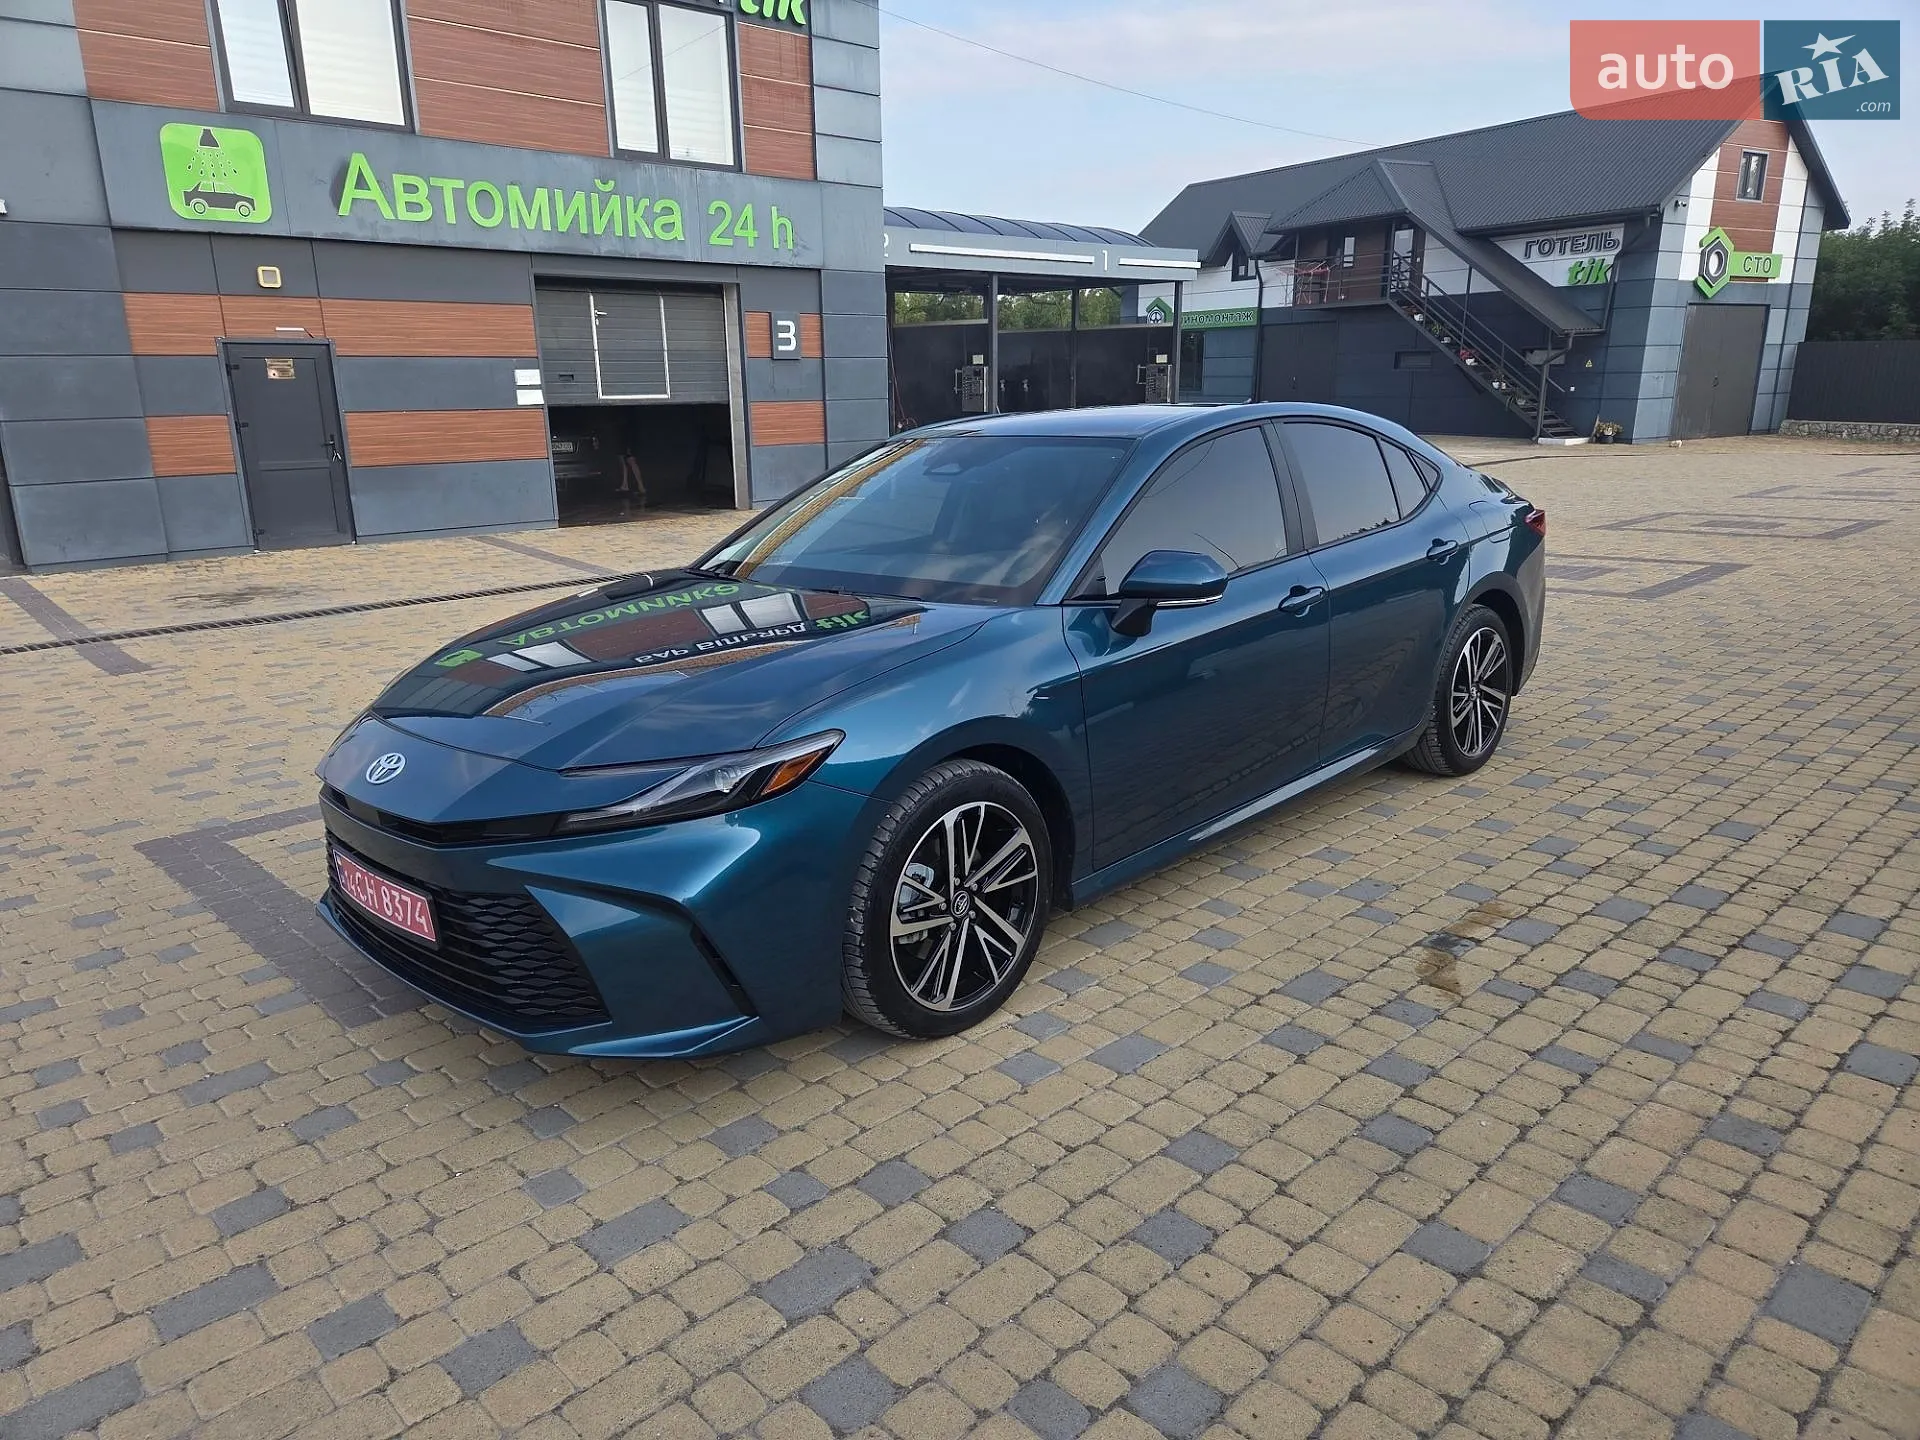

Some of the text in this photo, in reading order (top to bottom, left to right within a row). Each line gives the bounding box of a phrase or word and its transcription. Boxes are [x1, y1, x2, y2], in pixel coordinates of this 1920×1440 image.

[338, 152, 794, 250] Автомийка 24 h
[1523, 231, 1620, 259] ГОТЕЛЬ
[1567, 257, 1613, 286] tik
[1743, 254, 1772, 274] СТО
[777, 320, 797, 351] 3
[381, 885, 428, 933] 8374
